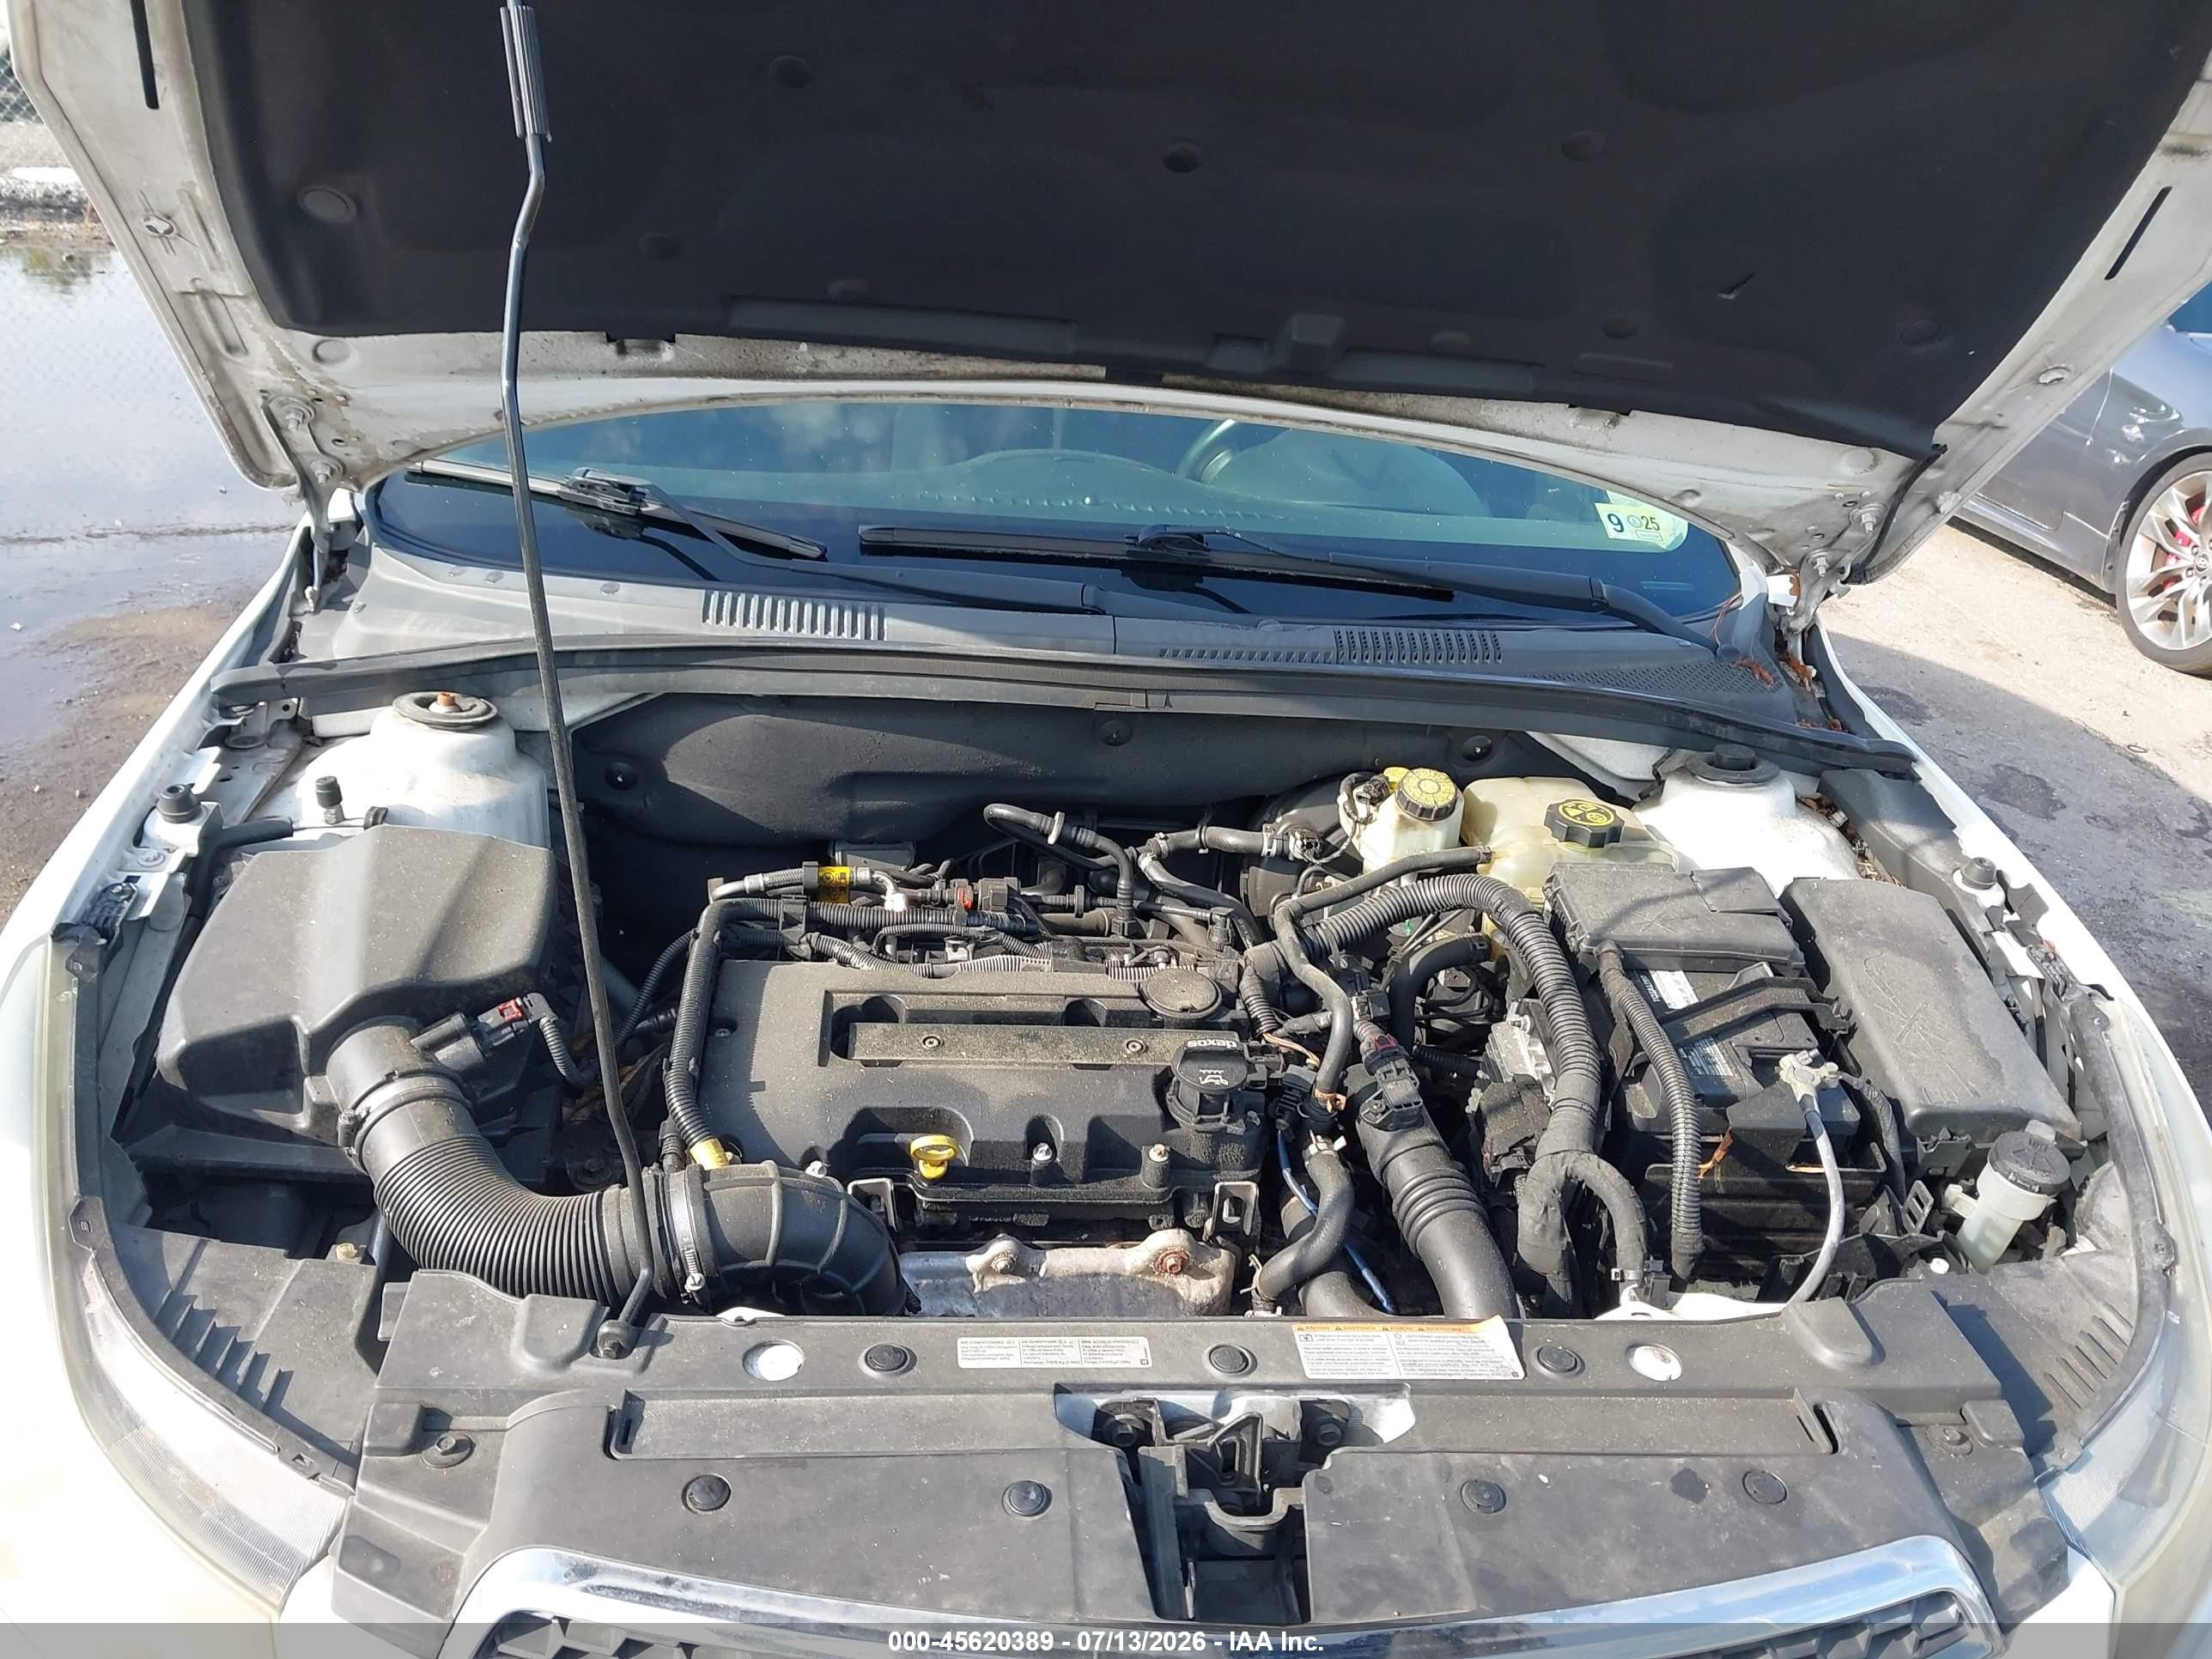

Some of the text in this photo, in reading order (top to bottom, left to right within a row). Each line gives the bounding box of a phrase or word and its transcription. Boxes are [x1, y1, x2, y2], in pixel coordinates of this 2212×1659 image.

[1607, 514, 1624, 532] 9
[1641, 516, 1660, 531] 25
[1187, 1039, 1237, 1048] dexos
